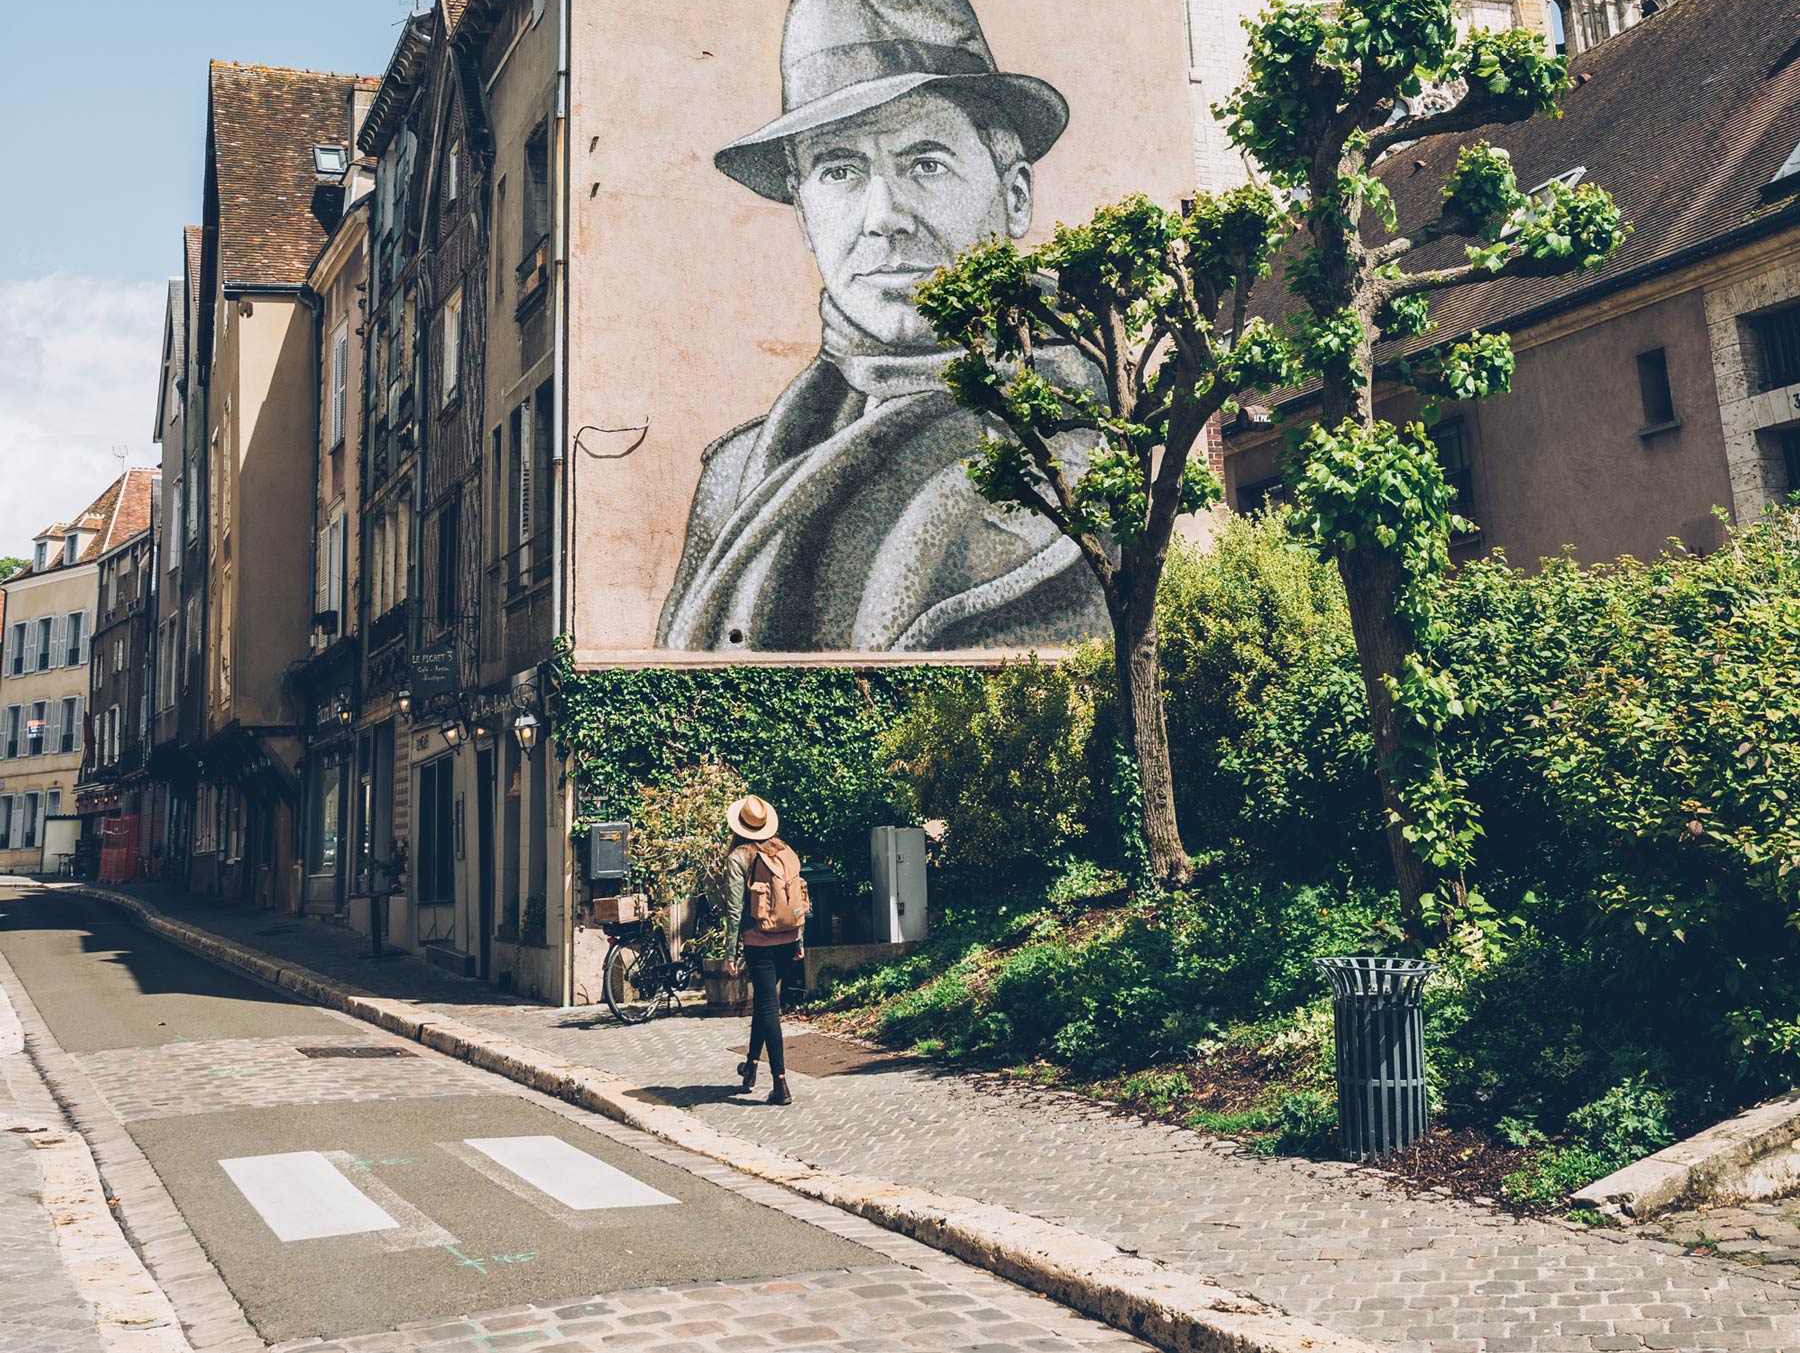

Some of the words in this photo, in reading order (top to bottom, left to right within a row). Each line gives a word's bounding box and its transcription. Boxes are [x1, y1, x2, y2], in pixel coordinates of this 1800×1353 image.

[412, 655, 421, 664] LE
[422, 653, 446, 664] PICHET
[446, 650, 454, 661] 3
